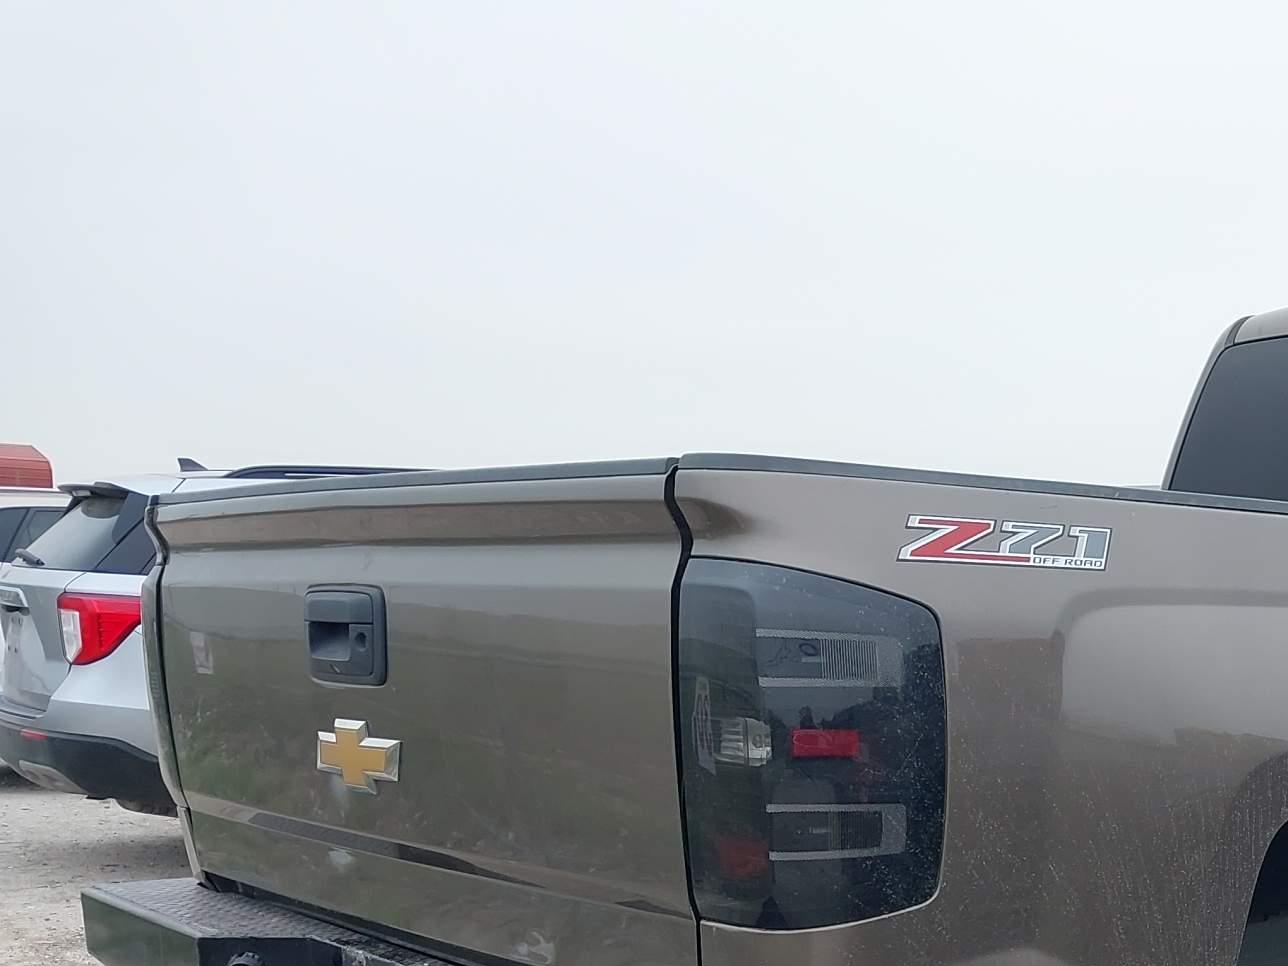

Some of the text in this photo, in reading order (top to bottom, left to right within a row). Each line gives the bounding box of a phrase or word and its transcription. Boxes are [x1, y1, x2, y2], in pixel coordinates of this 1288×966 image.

[896, 513, 1112, 571] Z71
[1032, 556, 1103, 568] OFF ROAD
